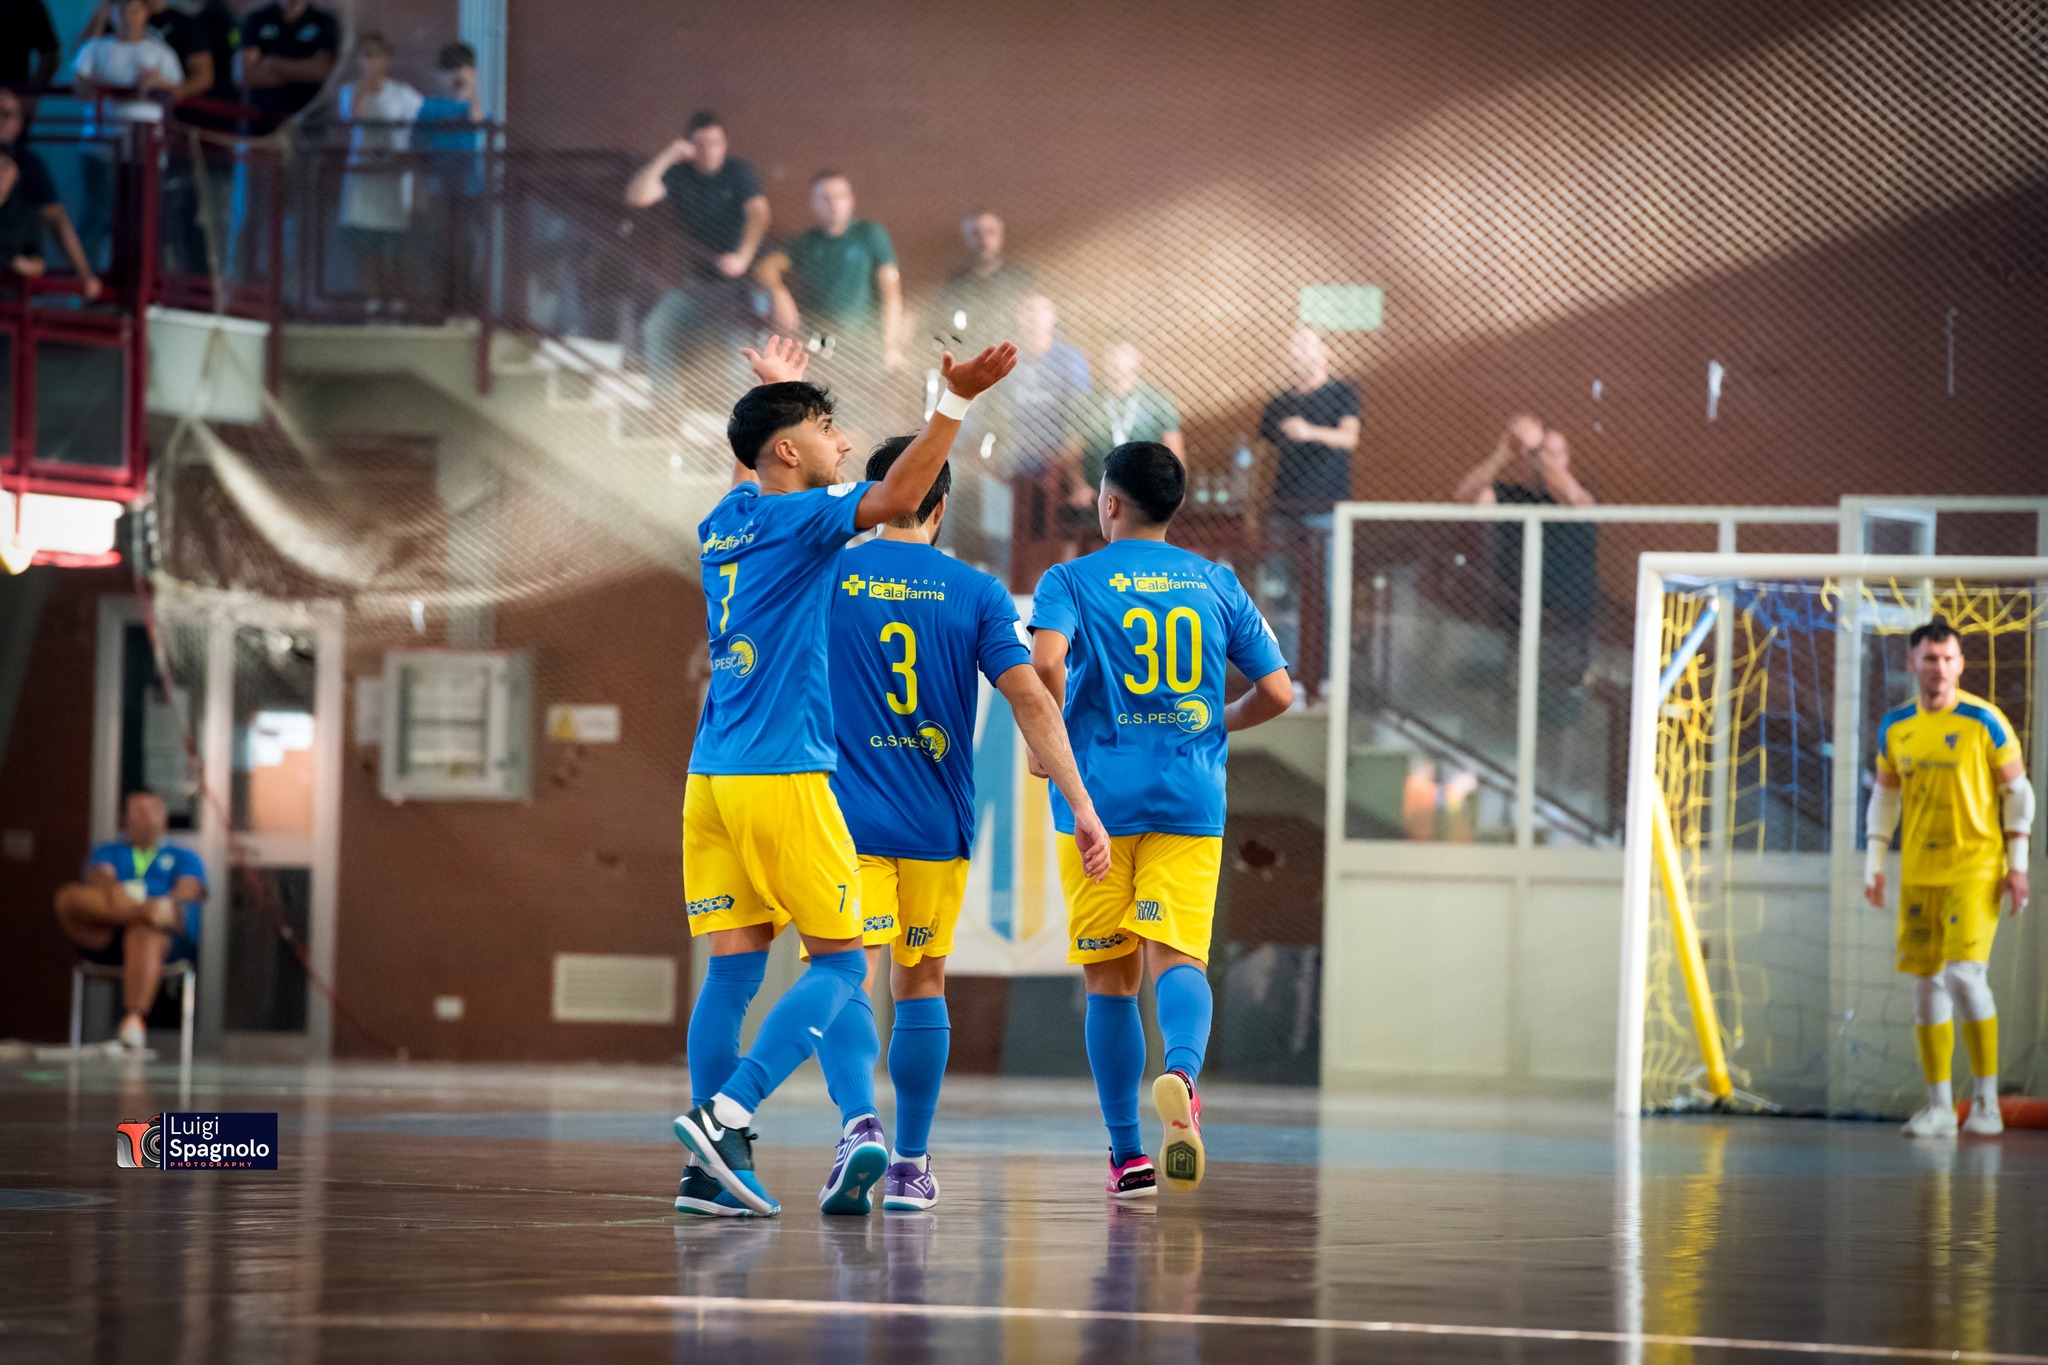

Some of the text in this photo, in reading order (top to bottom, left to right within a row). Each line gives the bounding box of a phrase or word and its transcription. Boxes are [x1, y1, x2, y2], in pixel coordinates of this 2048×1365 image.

[869, 575, 946, 588] FARMACIA
[869, 582, 945, 601] Calafarma
[1135, 579, 1208, 592] Calafarma
[719, 562, 739, 634] 7
[1122, 606, 1203, 695] 30
[879, 621, 918, 715] 3
[1117, 711, 1200, 725] G.S.PESCA
[837, 884, 847, 913] 7
